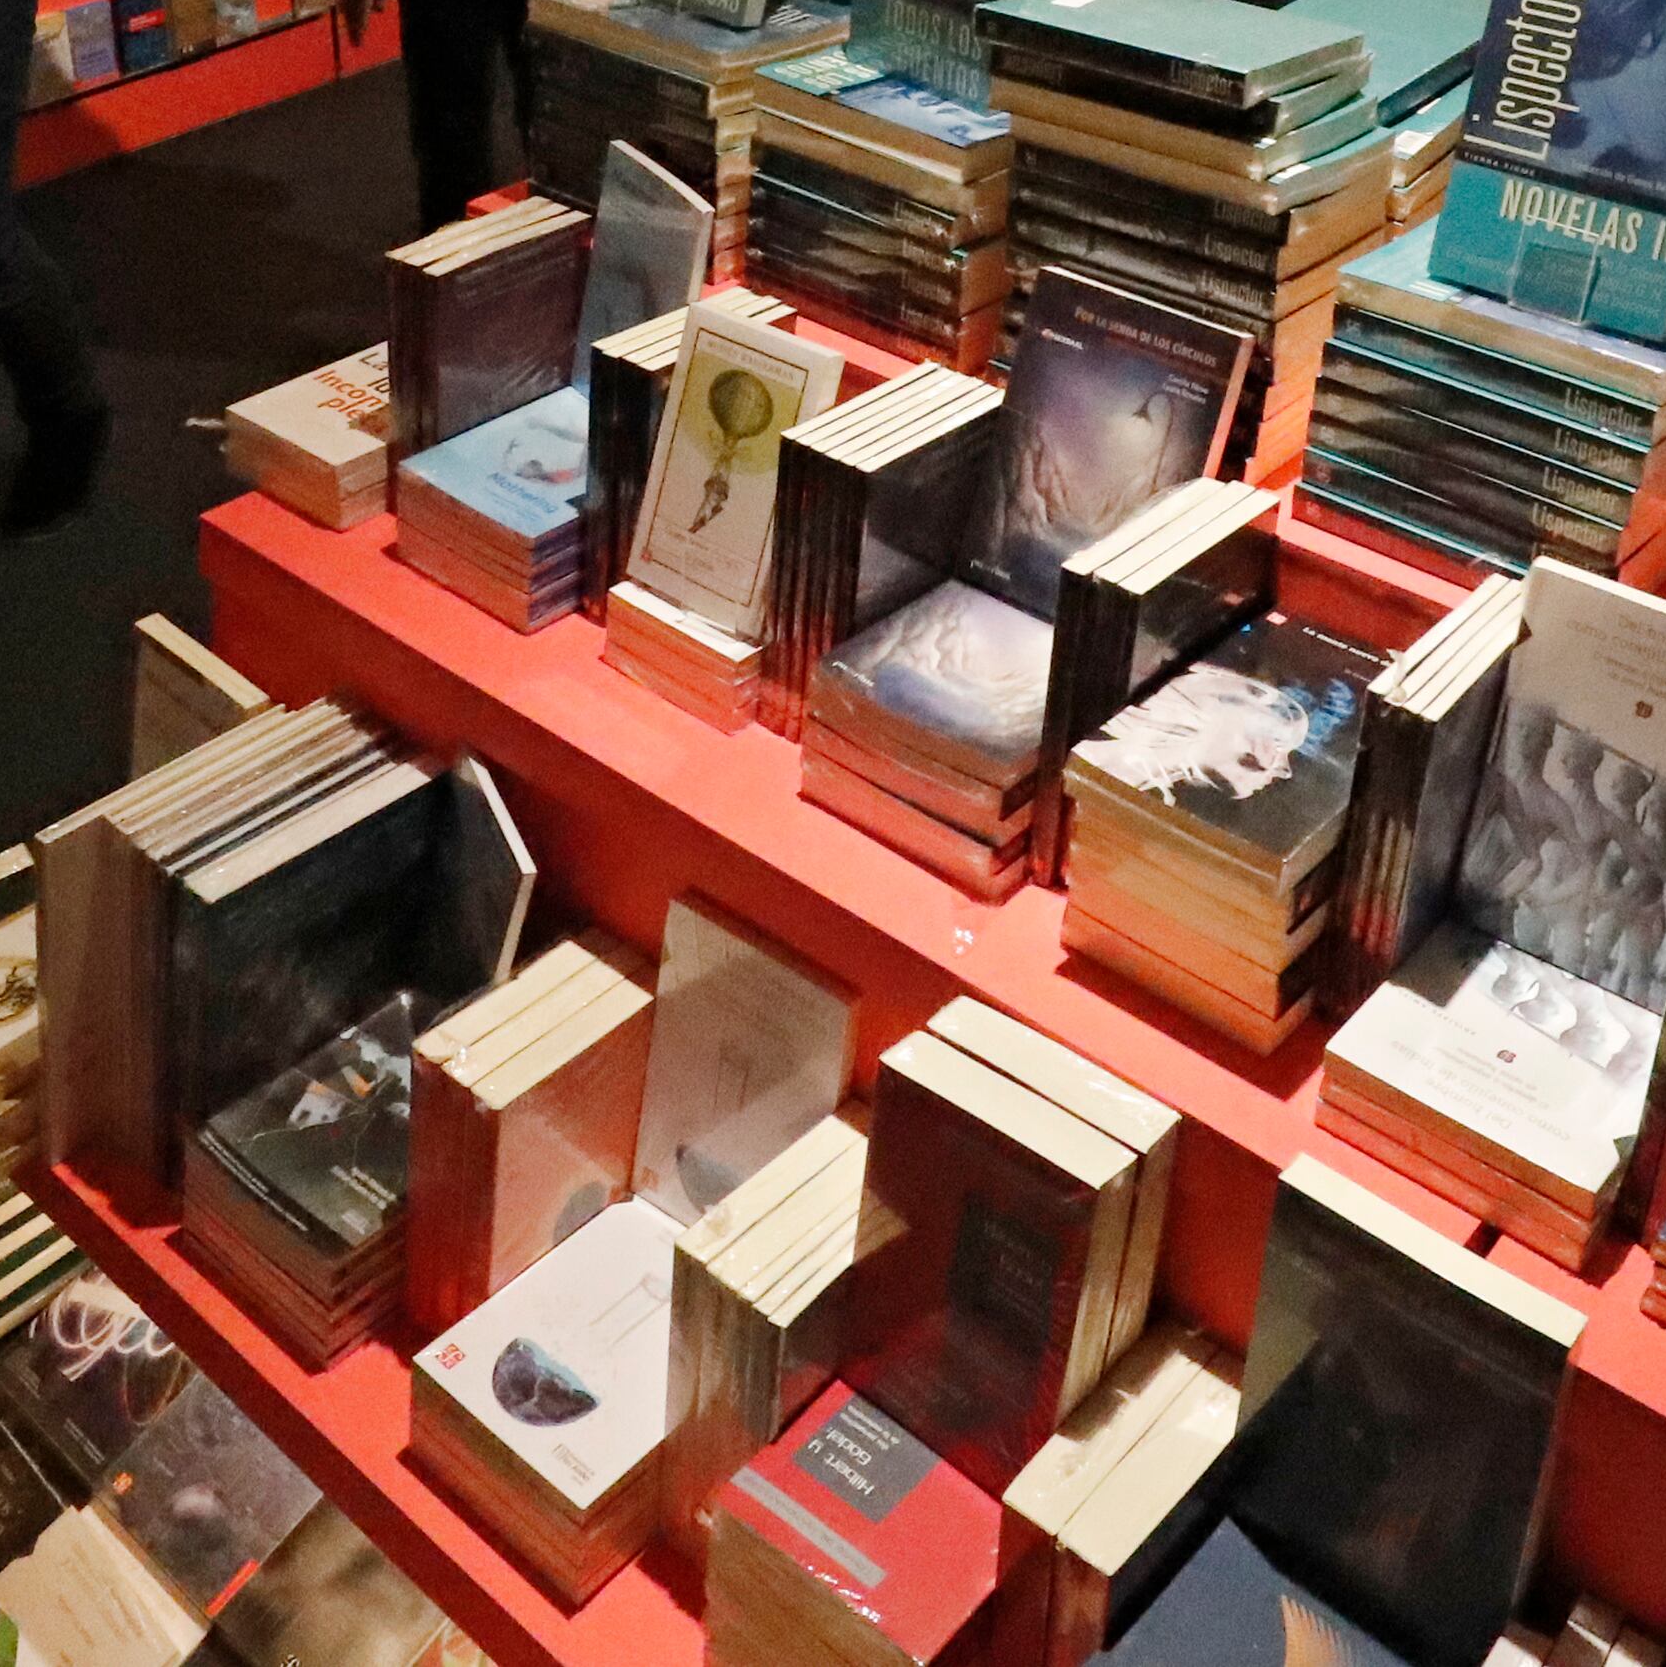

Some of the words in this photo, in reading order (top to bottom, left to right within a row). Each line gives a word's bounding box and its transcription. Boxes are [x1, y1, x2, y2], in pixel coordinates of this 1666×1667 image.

[1499, 178, 1645, 254] NOVELAS
[1203, 232, 1269, 272] Lispector
[1200, 269, 1263, 308] Lispector
[1138, 330, 1153, 344] DE
[1153, 335, 1172, 353] LOS
[1171, 340, 1218, 369] CÍRCULOS
[1563, 387, 1644, 428] Lispector
[1554, 427, 1631, 472] Lispector
[1541, 465, 1619, 509] Lispector
[1531, 502, 1609, 549] Lispector
[1565, 618, 1608, 641] como
[1617, 613, 1644, 632] Del
[1422, 1075, 1486, 1116] hombre
[807, 1438, 824, 1455] y
[823, 1452, 875, 1495] Hilbert
